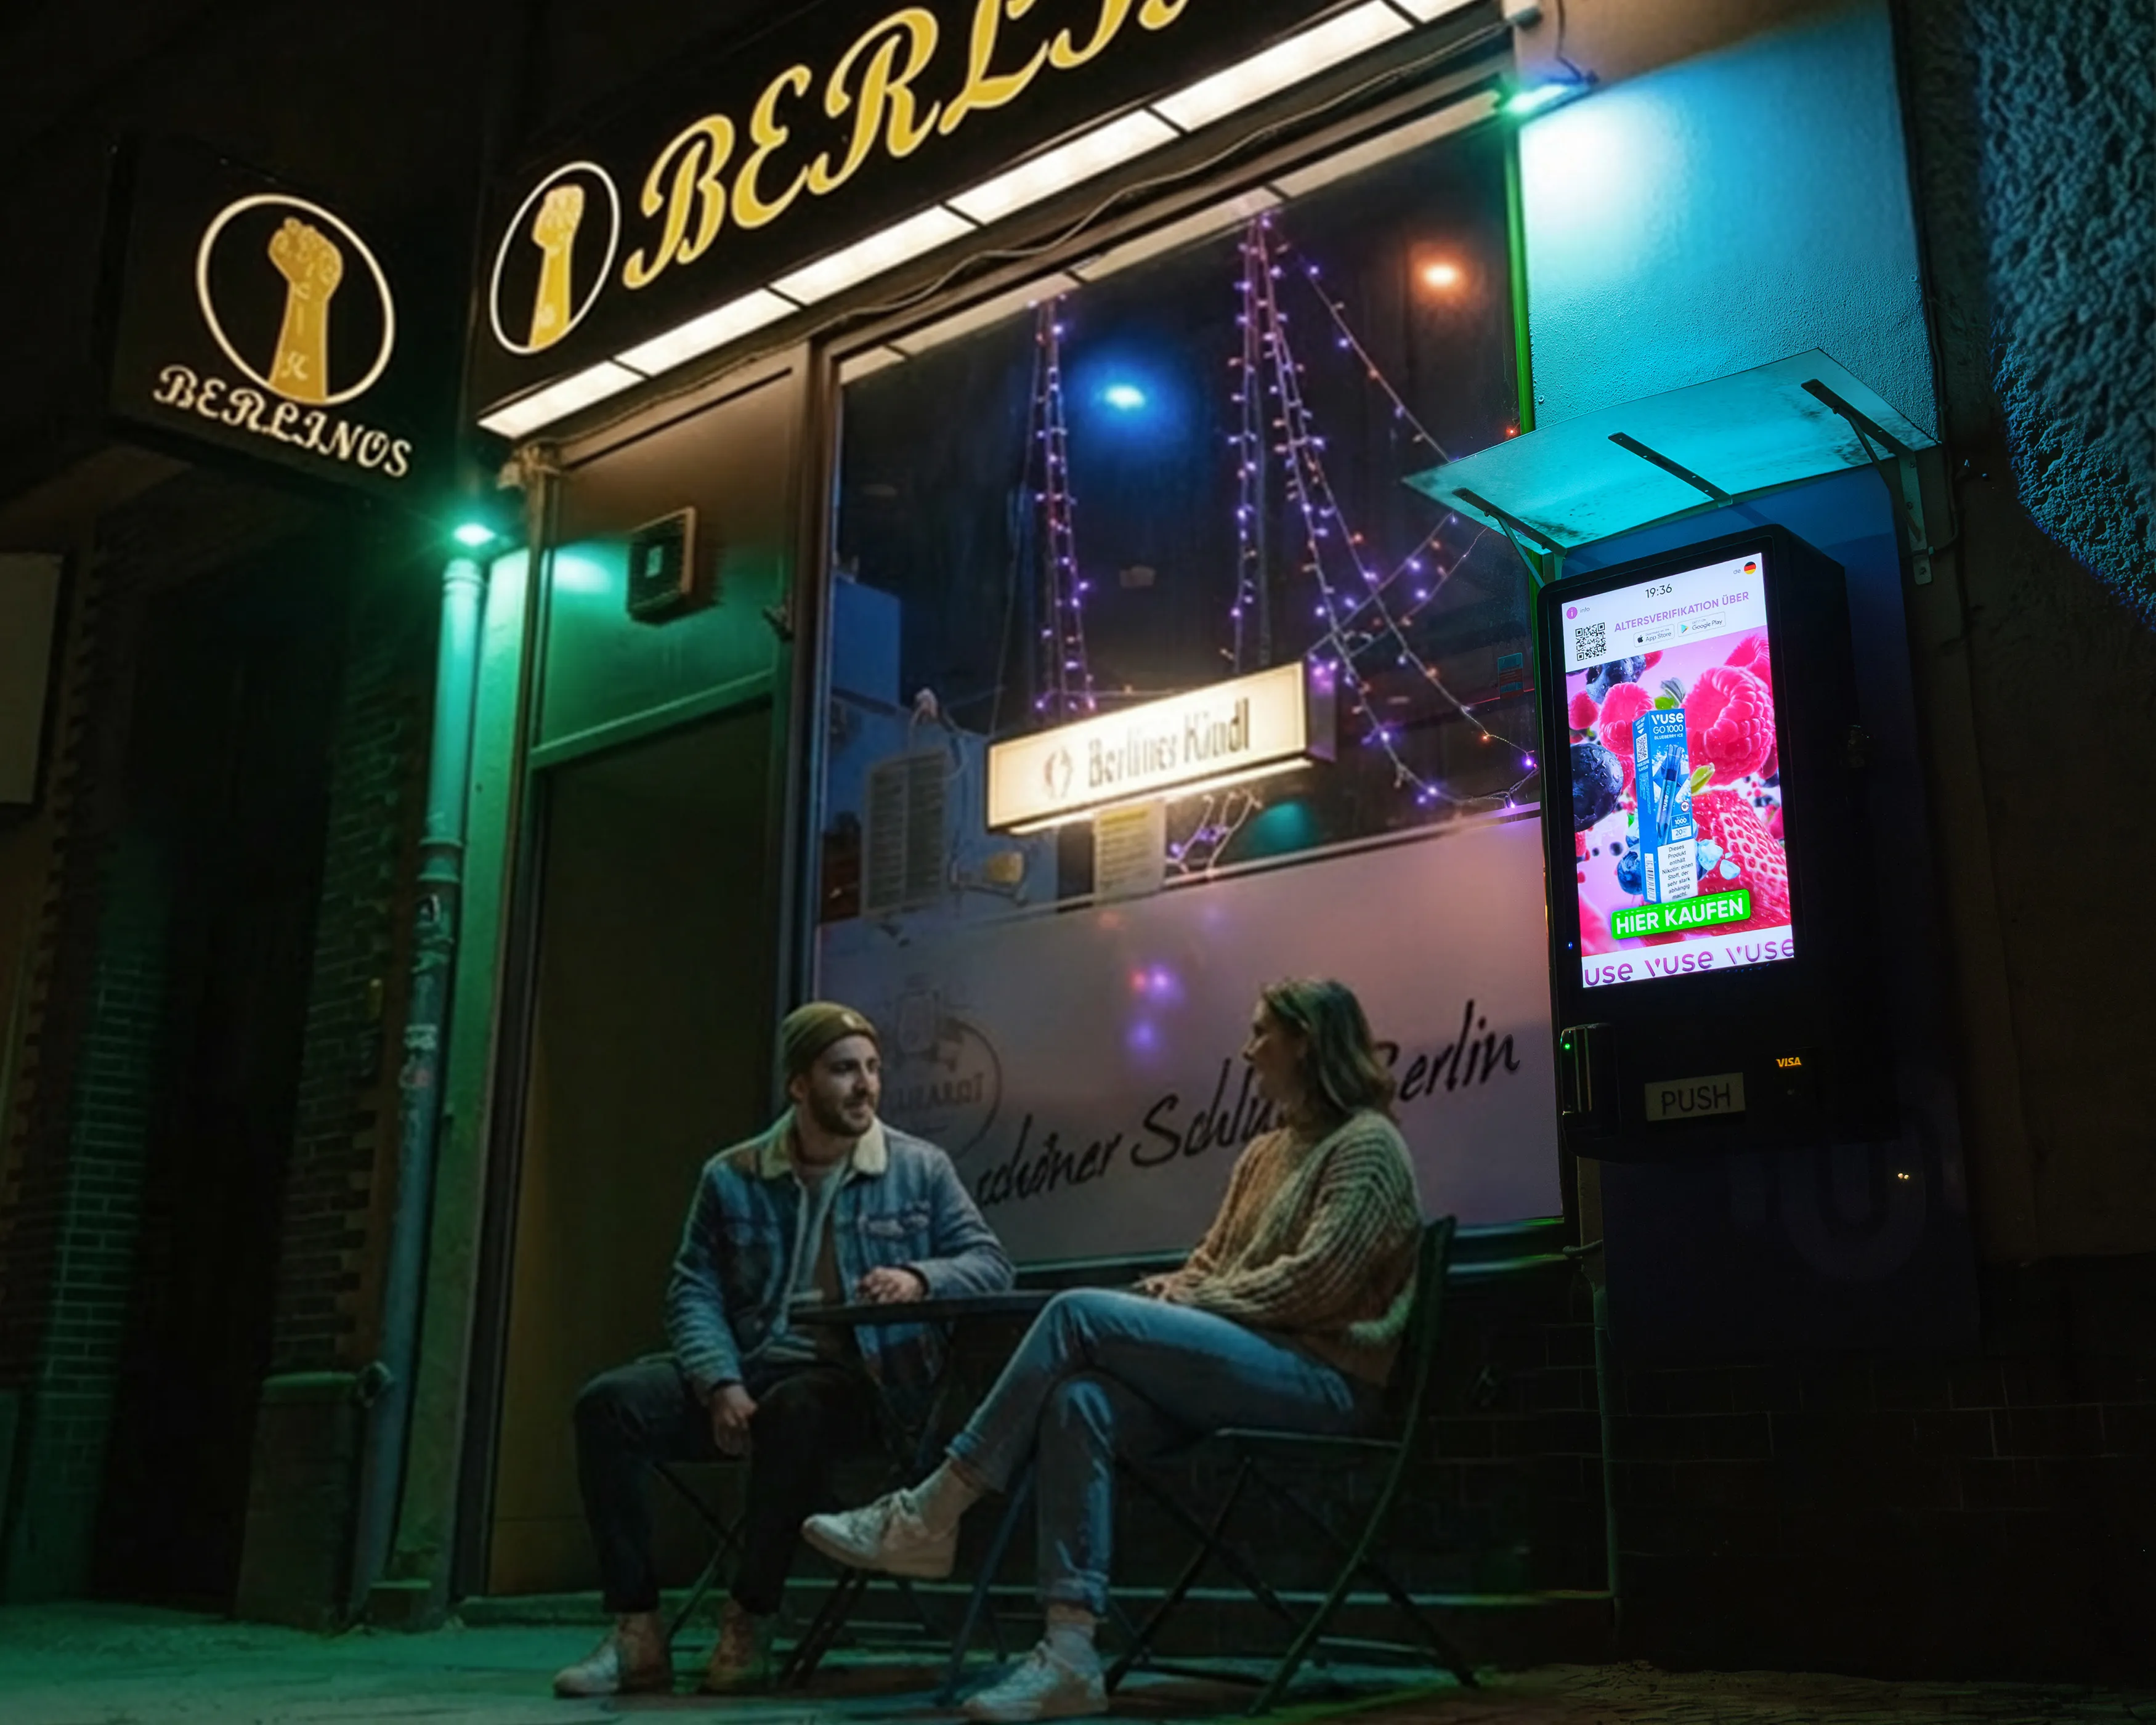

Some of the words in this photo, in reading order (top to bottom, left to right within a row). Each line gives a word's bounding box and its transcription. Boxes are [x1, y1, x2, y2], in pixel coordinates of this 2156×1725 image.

[153, 364, 413, 477] BERLINOS
[1645, 583, 1673, 599] 19:36
[1614, 598, 1719, 632] ALTERSVERIFIKATION
[1722, 591, 1749, 606] ÜBER
[1692, 621, 1711, 630] Google
[1711, 619, 1723, 627] Play
[1653, 726, 1666, 734] GO
[1666, 724, 1684, 733] 1000
[1088, 729, 1178, 788] Berliner
[1183, 697, 1251, 764] Kindl
[1668, 844, 1685, 852] Dieses
[1668, 850, 1686, 859] Produkt
[1669, 857, 1686, 866] enthält
[1668, 872, 1680, 880] Stoff,
[1668, 884, 1690, 894] abhängig
[1615, 911, 1660, 935] HIER
[1664, 897, 1744, 927] KAUFEN
[1775, 1057, 1802, 1068] VISA
[1661, 1082, 1731, 1116] PUSH
